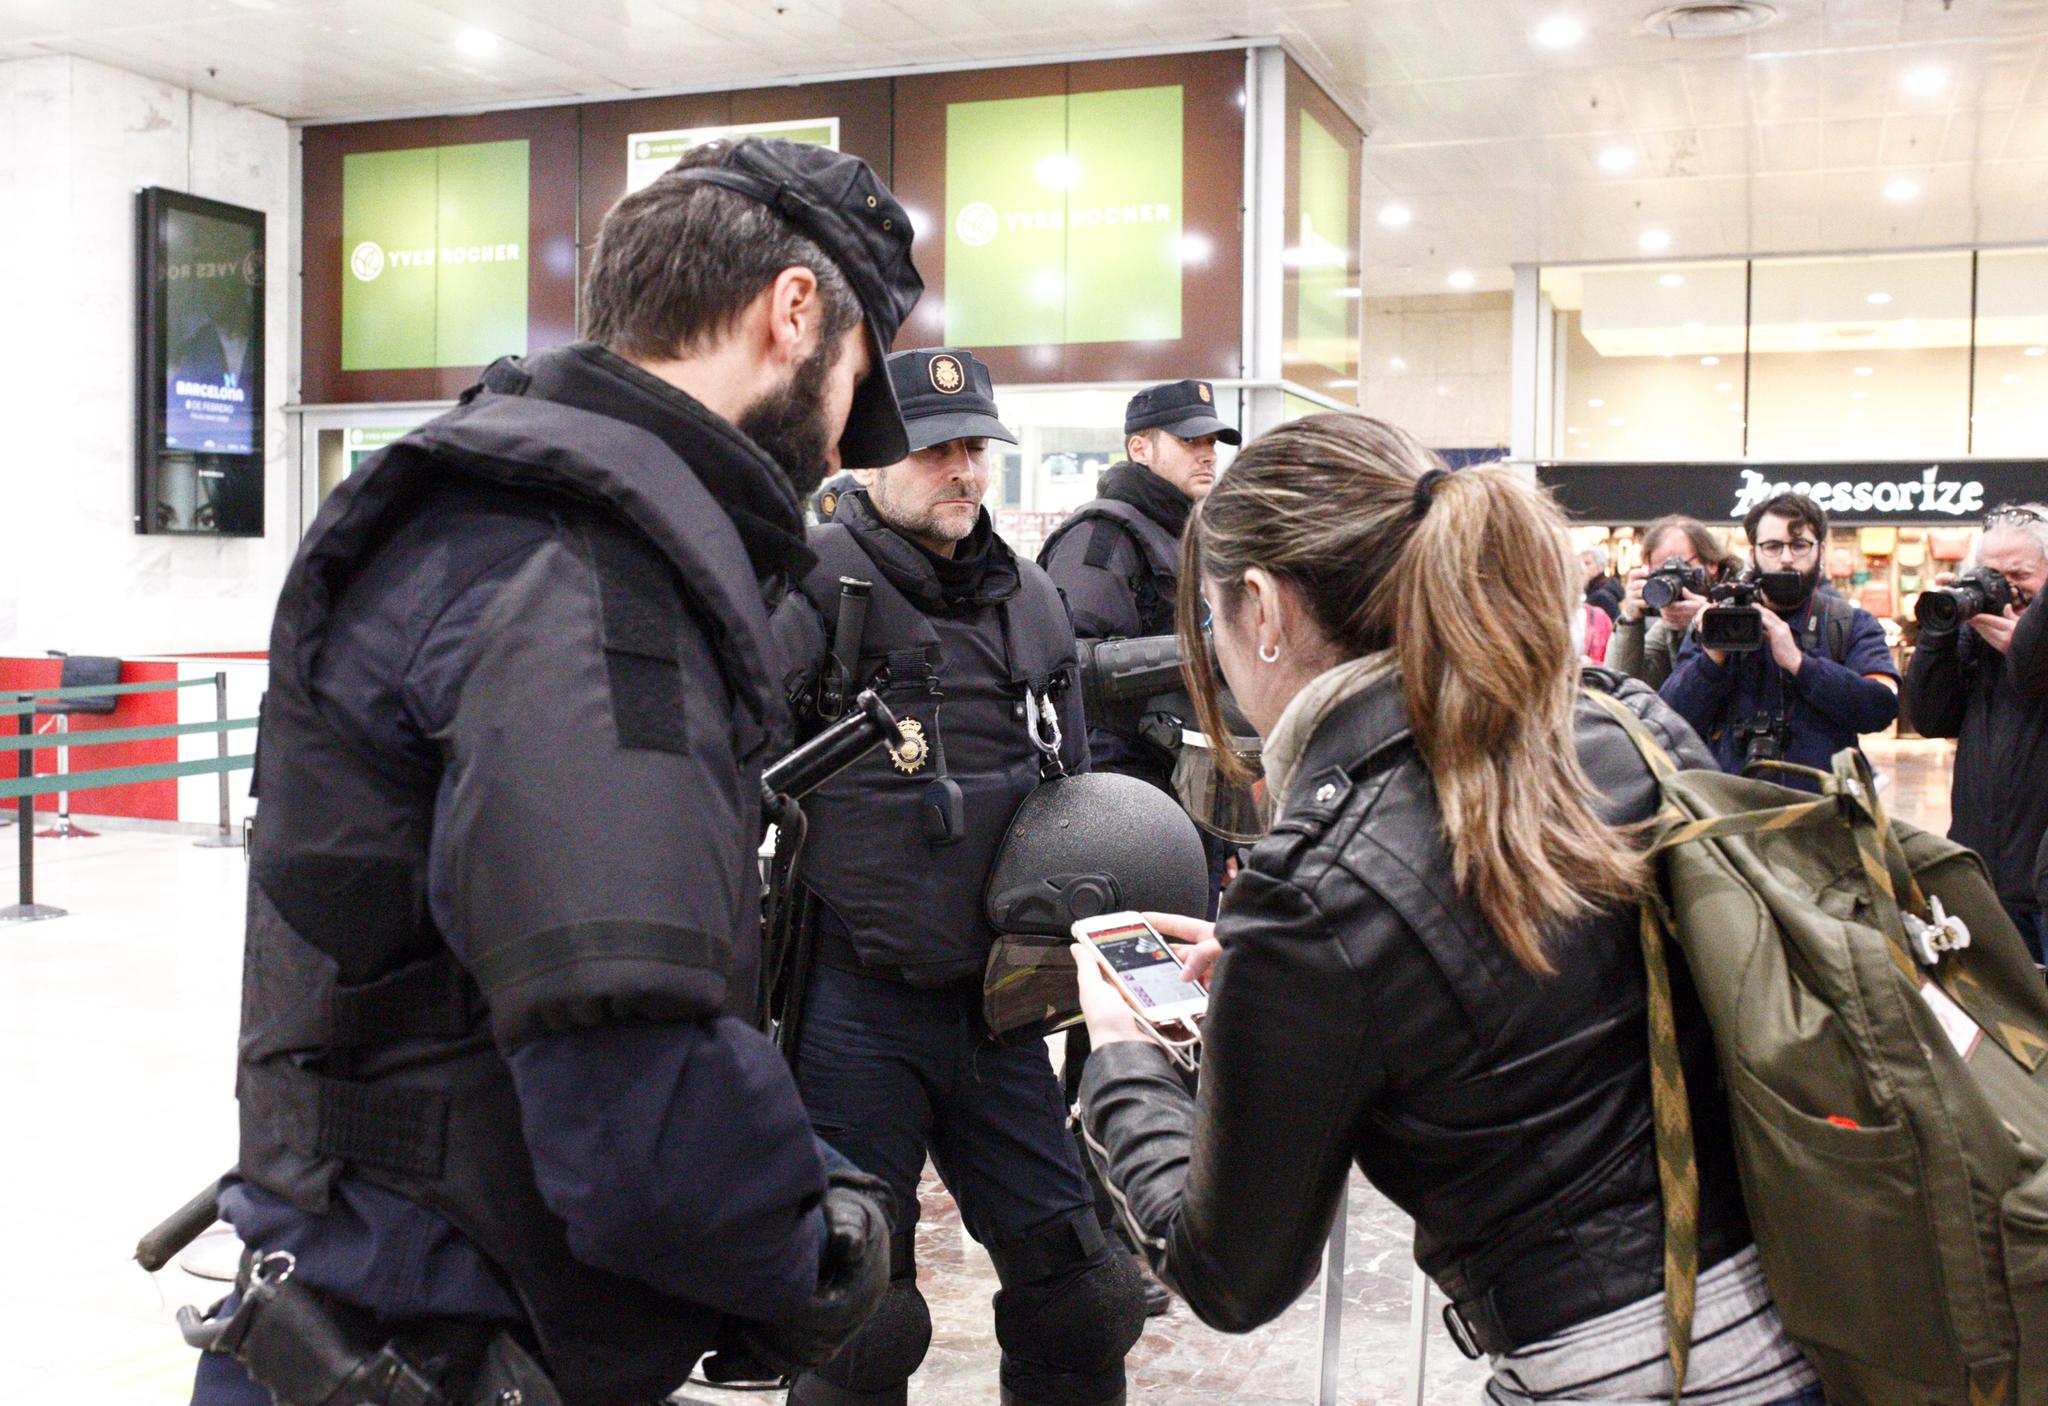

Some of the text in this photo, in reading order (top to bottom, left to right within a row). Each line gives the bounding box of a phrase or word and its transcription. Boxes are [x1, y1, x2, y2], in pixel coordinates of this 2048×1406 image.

[1003, 203, 1171, 231] YVES ROCHER
[388, 243, 519, 267] YVES ROCHER
[176, 380, 244, 402] BARCELONA
